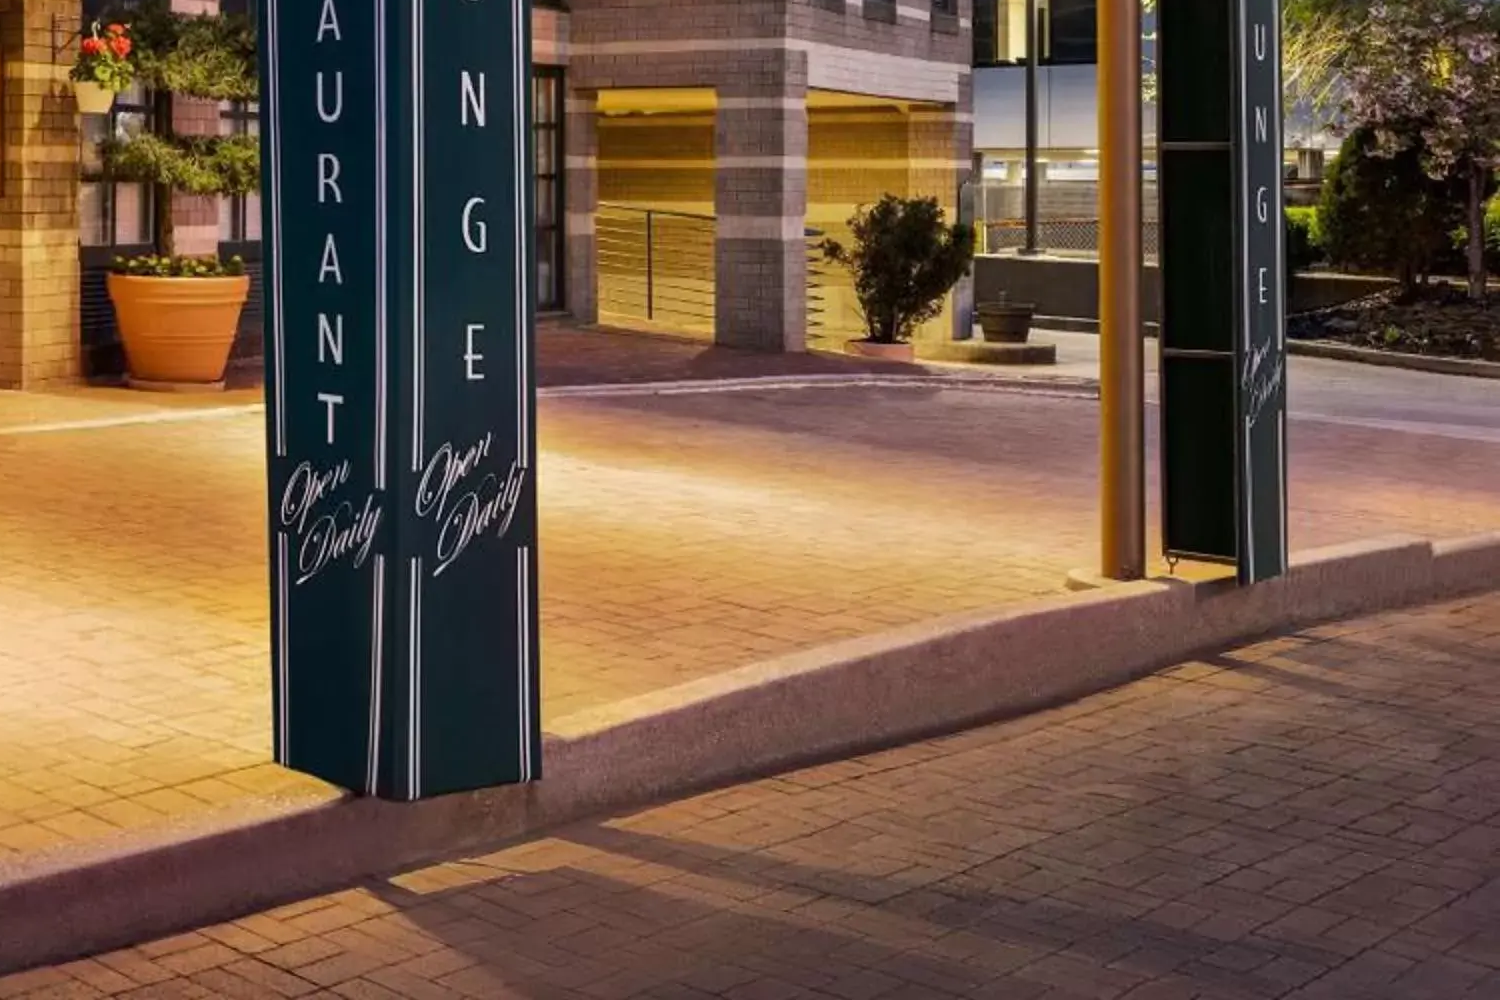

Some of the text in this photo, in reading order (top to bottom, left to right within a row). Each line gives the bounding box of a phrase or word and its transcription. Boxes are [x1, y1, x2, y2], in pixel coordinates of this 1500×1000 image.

[281, 460, 351, 535] Open
[415, 431, 492, 522] Open
[433, 459, 525, 577] Daily
[296, 493, 382, 585] Daily
